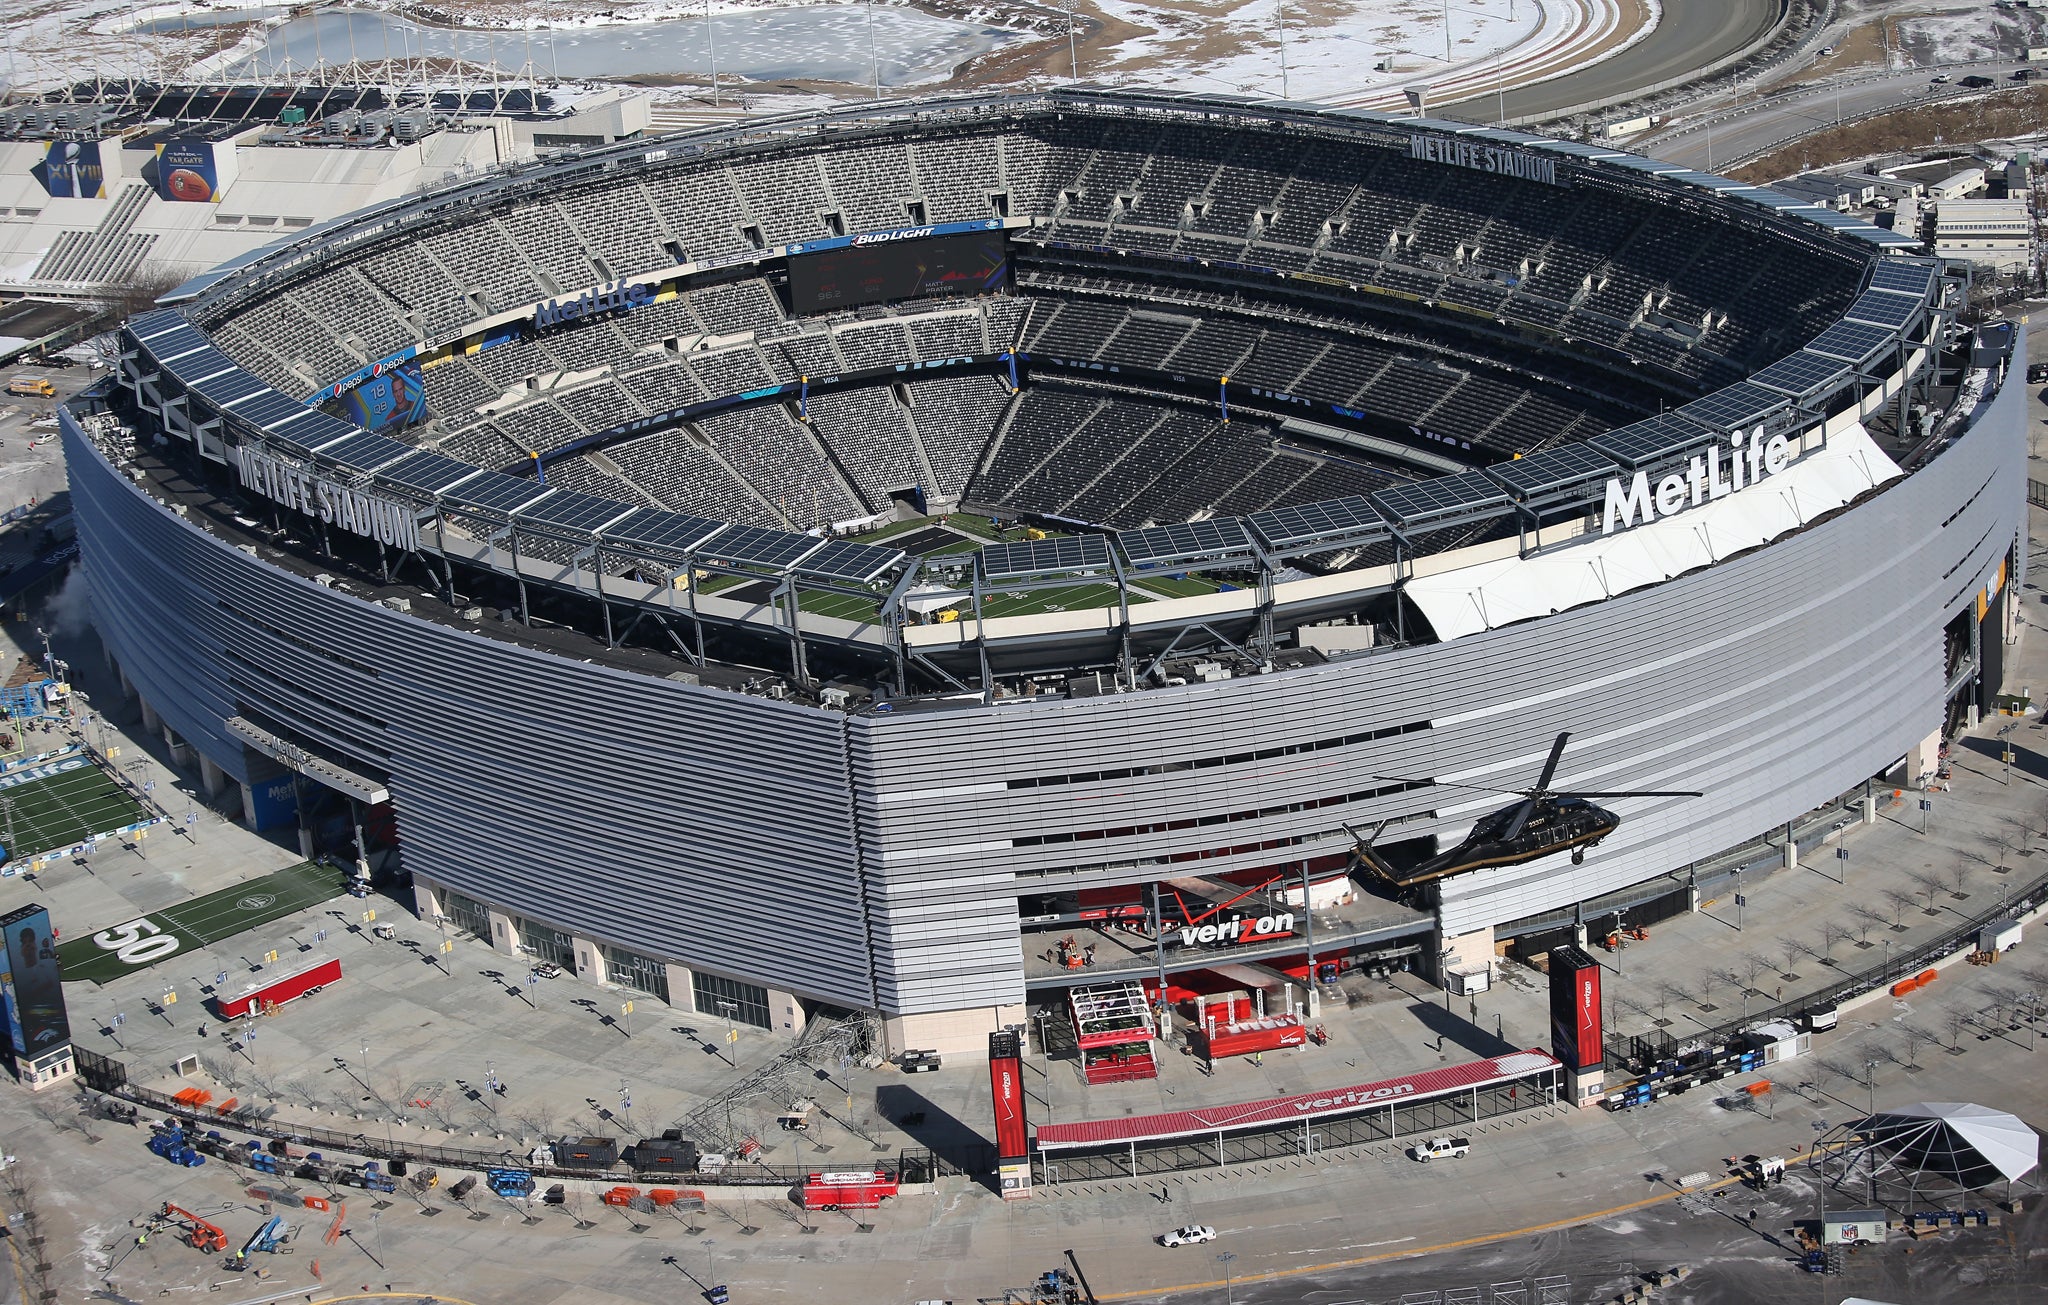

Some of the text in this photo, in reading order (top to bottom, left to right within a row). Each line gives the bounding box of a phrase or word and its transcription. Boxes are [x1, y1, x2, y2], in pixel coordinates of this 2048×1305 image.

[1410, 134, 1556, 185] METLIFE STADIUM
[856, 227, 935, 246] BUD LIGHT
[925, 286, 954, 294] PRATER
[534, 277, 647, 330] MetLife
[383, 353, 406, 374] pepsi
[342, 372, 362, 394] pepsi
[822, 376, 839, 384] VISA
[1172, 374, 1185, 382] VISA
[370, 383, 386, 400] 18
[312, 394, 324, 411] epsi
[373, 401, 388, 415] QB
[1601, 424, 1789, 536] MetLife
[236, 445, 416, 553] METLIFE STADIUM
[474, 903, 489, 918] CLU
[1181, 912, 1295, 946] verizon
[93, 917, 180, 965] 50
[554, 933, 573, 948] CLU
[1583, 980, 1592, 1009] verizon
[1001, 1071, 1011, 1100] verizon
[1294, 1082, 1414, 1111] verizon
[1843, 1230, 1858, 1239] NFL
